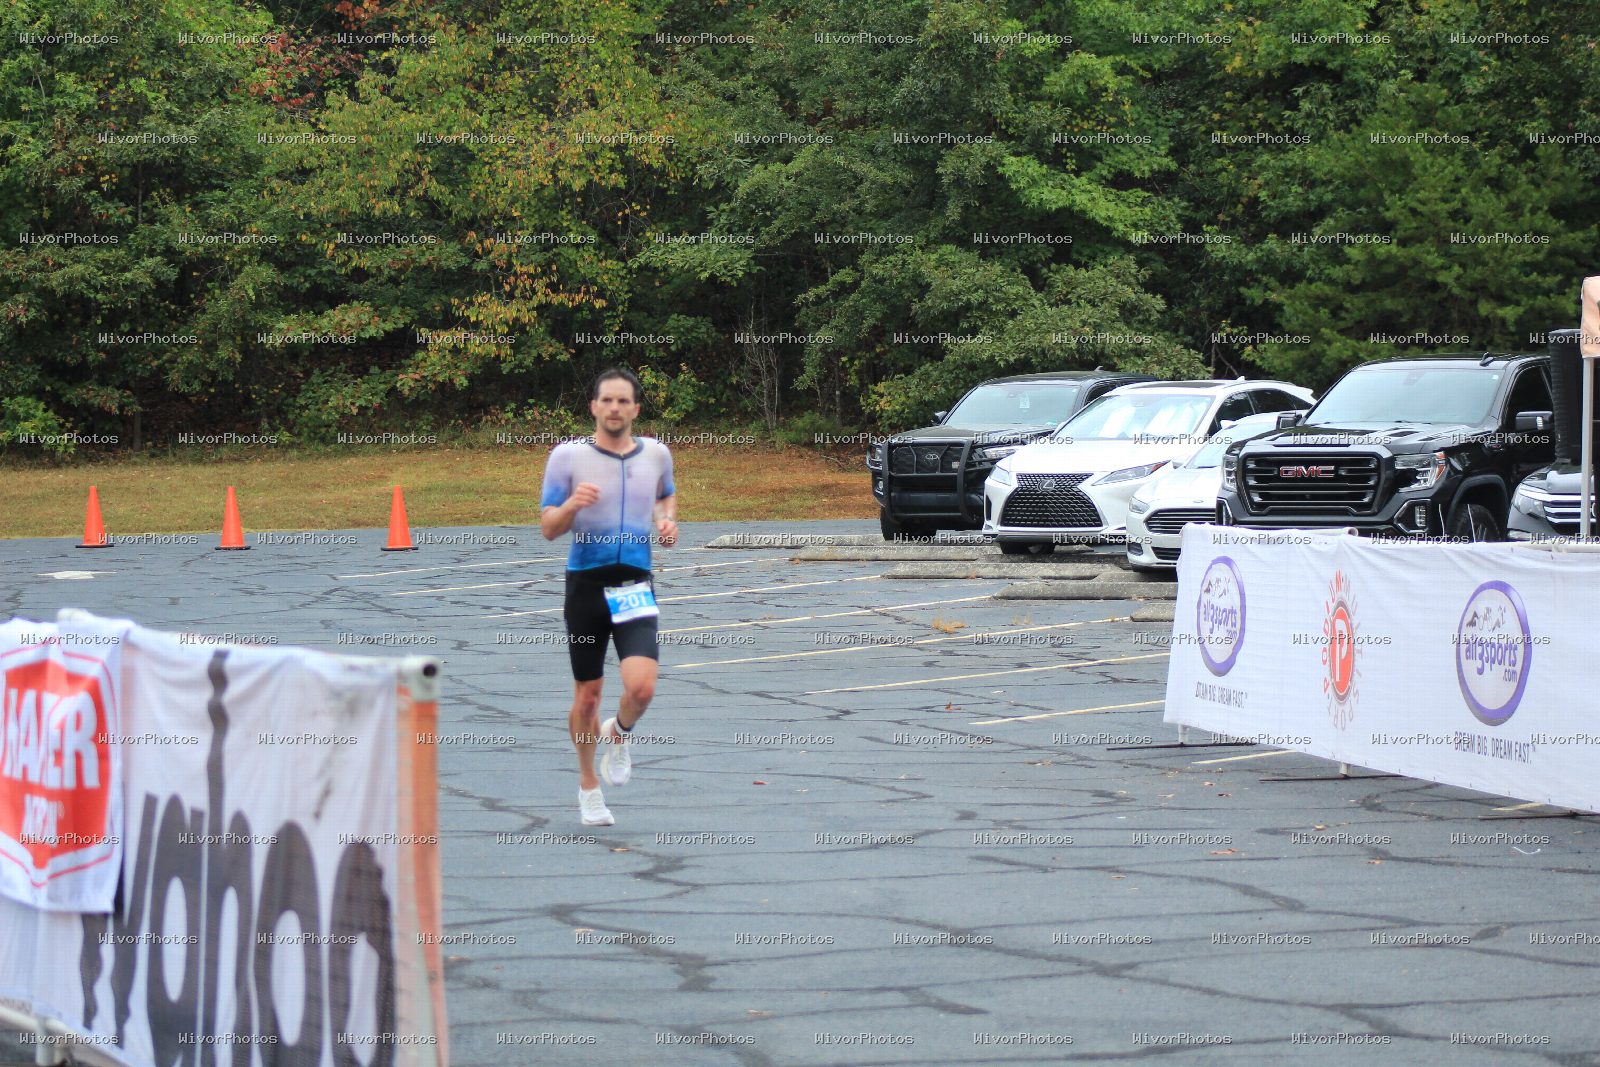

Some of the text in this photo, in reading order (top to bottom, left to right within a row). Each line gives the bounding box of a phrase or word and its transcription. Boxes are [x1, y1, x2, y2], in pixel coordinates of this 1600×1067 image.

[1280, 466, 1335, 477] GMC
[616, 592, 648, 611] 201
[1335, 618, 1348, 682] P
[1465, 633, 1518, 675] all3sports
[1502, 668, 1518, 682] .com
[1454, 731, 1476, 753] DREAM
[1477, 735, 1489, 757] BIG.
[1491, 738, 1513, 760] DREAM
